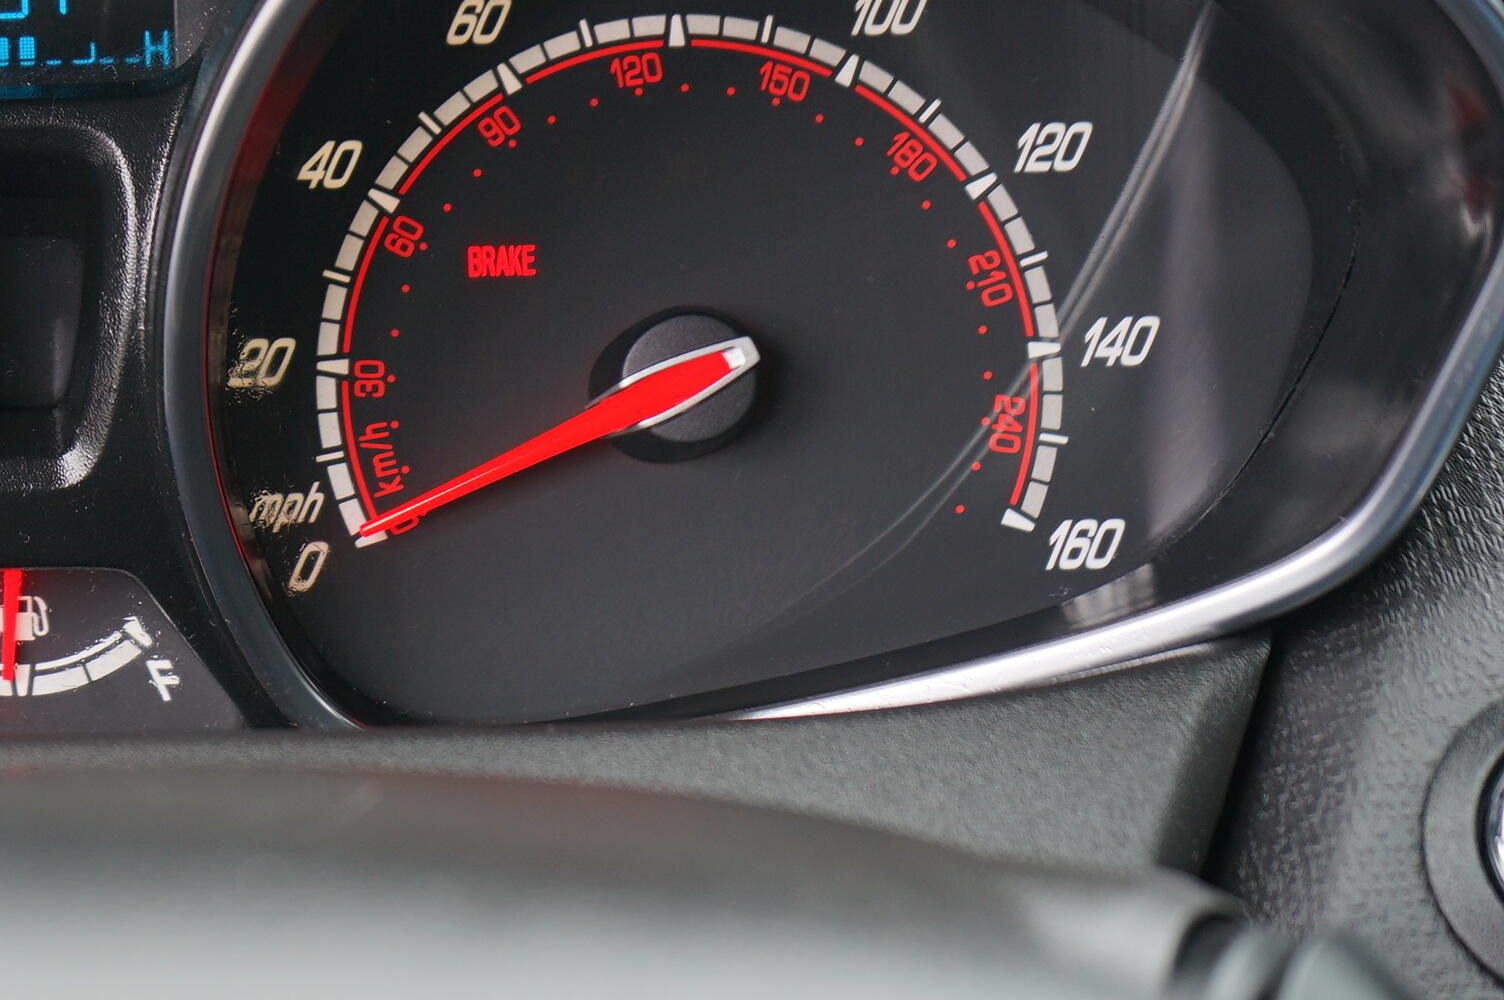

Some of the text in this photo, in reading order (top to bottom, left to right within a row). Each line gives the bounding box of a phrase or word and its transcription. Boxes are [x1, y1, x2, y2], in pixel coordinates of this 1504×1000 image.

[144, 30, 172, 66] H
[610, 52, 663, 88] 120
[759, 60, 811, 101] 150
[477, 105, 521, 147] 90
[1014, 121, 1093, 172] 120
[296, 140, 363, 190] 40
[885, 132, 937, 182] 180
[384, 215, 424, 258] 60
[467, 244, 537, 278] BRAKE
[967, 249, 1013, 307] 210
[225, 337, 296, 389] 20
[1080, 315, 1161, 368] 140
[353, 359, 386, 398] 30
[988, 394, 1026, 454] 240
[358, 421, 405, 498] km/h
[248, 481, 325, 534] mph
[288, 540, 330, 594] 0
[1045, 518, 1127, 571] 160
[146, 659, 181, 702] F
